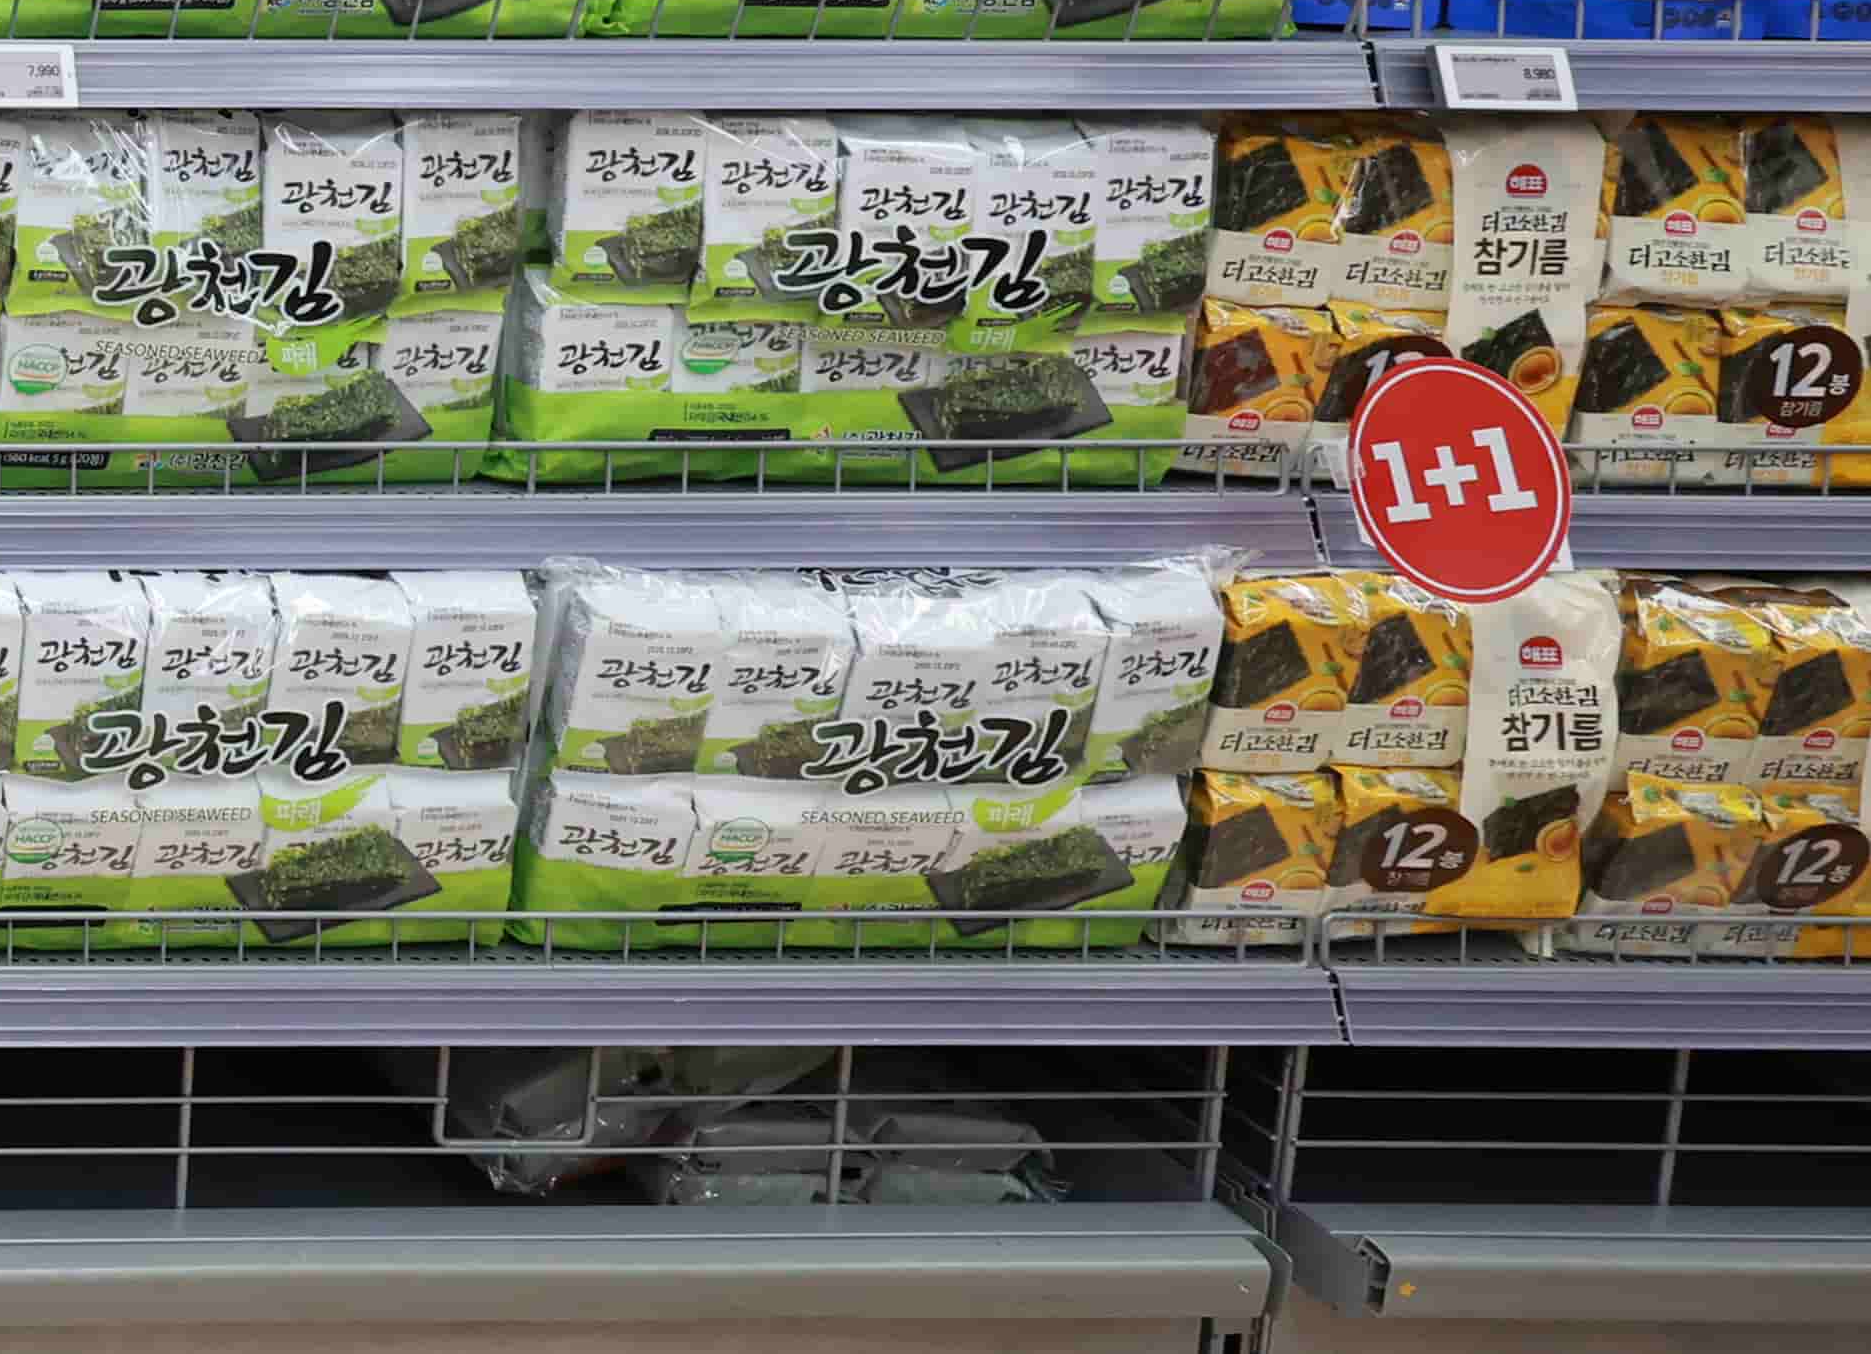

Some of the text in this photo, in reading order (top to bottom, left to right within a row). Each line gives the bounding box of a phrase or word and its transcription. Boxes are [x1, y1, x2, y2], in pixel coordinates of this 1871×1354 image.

[1481, 211, 1568, 235] 더고소한김
[1473, 238, 1570, 276] 참기름
[93, 243, 346, 326] 광천김
[776, 229, 1049, 316] 광천김
[1222, 259, 1318, 289] 더고소한김
[1346, 259, 1446, 291] 더고소한김
[96, 340, 259, 364] SEASONED SEAWEED
[280, 341, 318, 368] 파래
[1370, 427, 1539, 524] 1+1
[1507, 684, 1599, 710] 더고소한김
[81, 700, 353, 789] 광천김
[1219, 732, 1319, 754] 더고소한김
[1347, 728, 1449, 752] 더고소한김
[1502, 712, 1603, 753] 참기름
[801, 708, 1070, 795] 광천김
[91, 807, 251, 824] SEASONED SEAWEED
[802, 810, 963, 823] SEASONED SEAWEED
